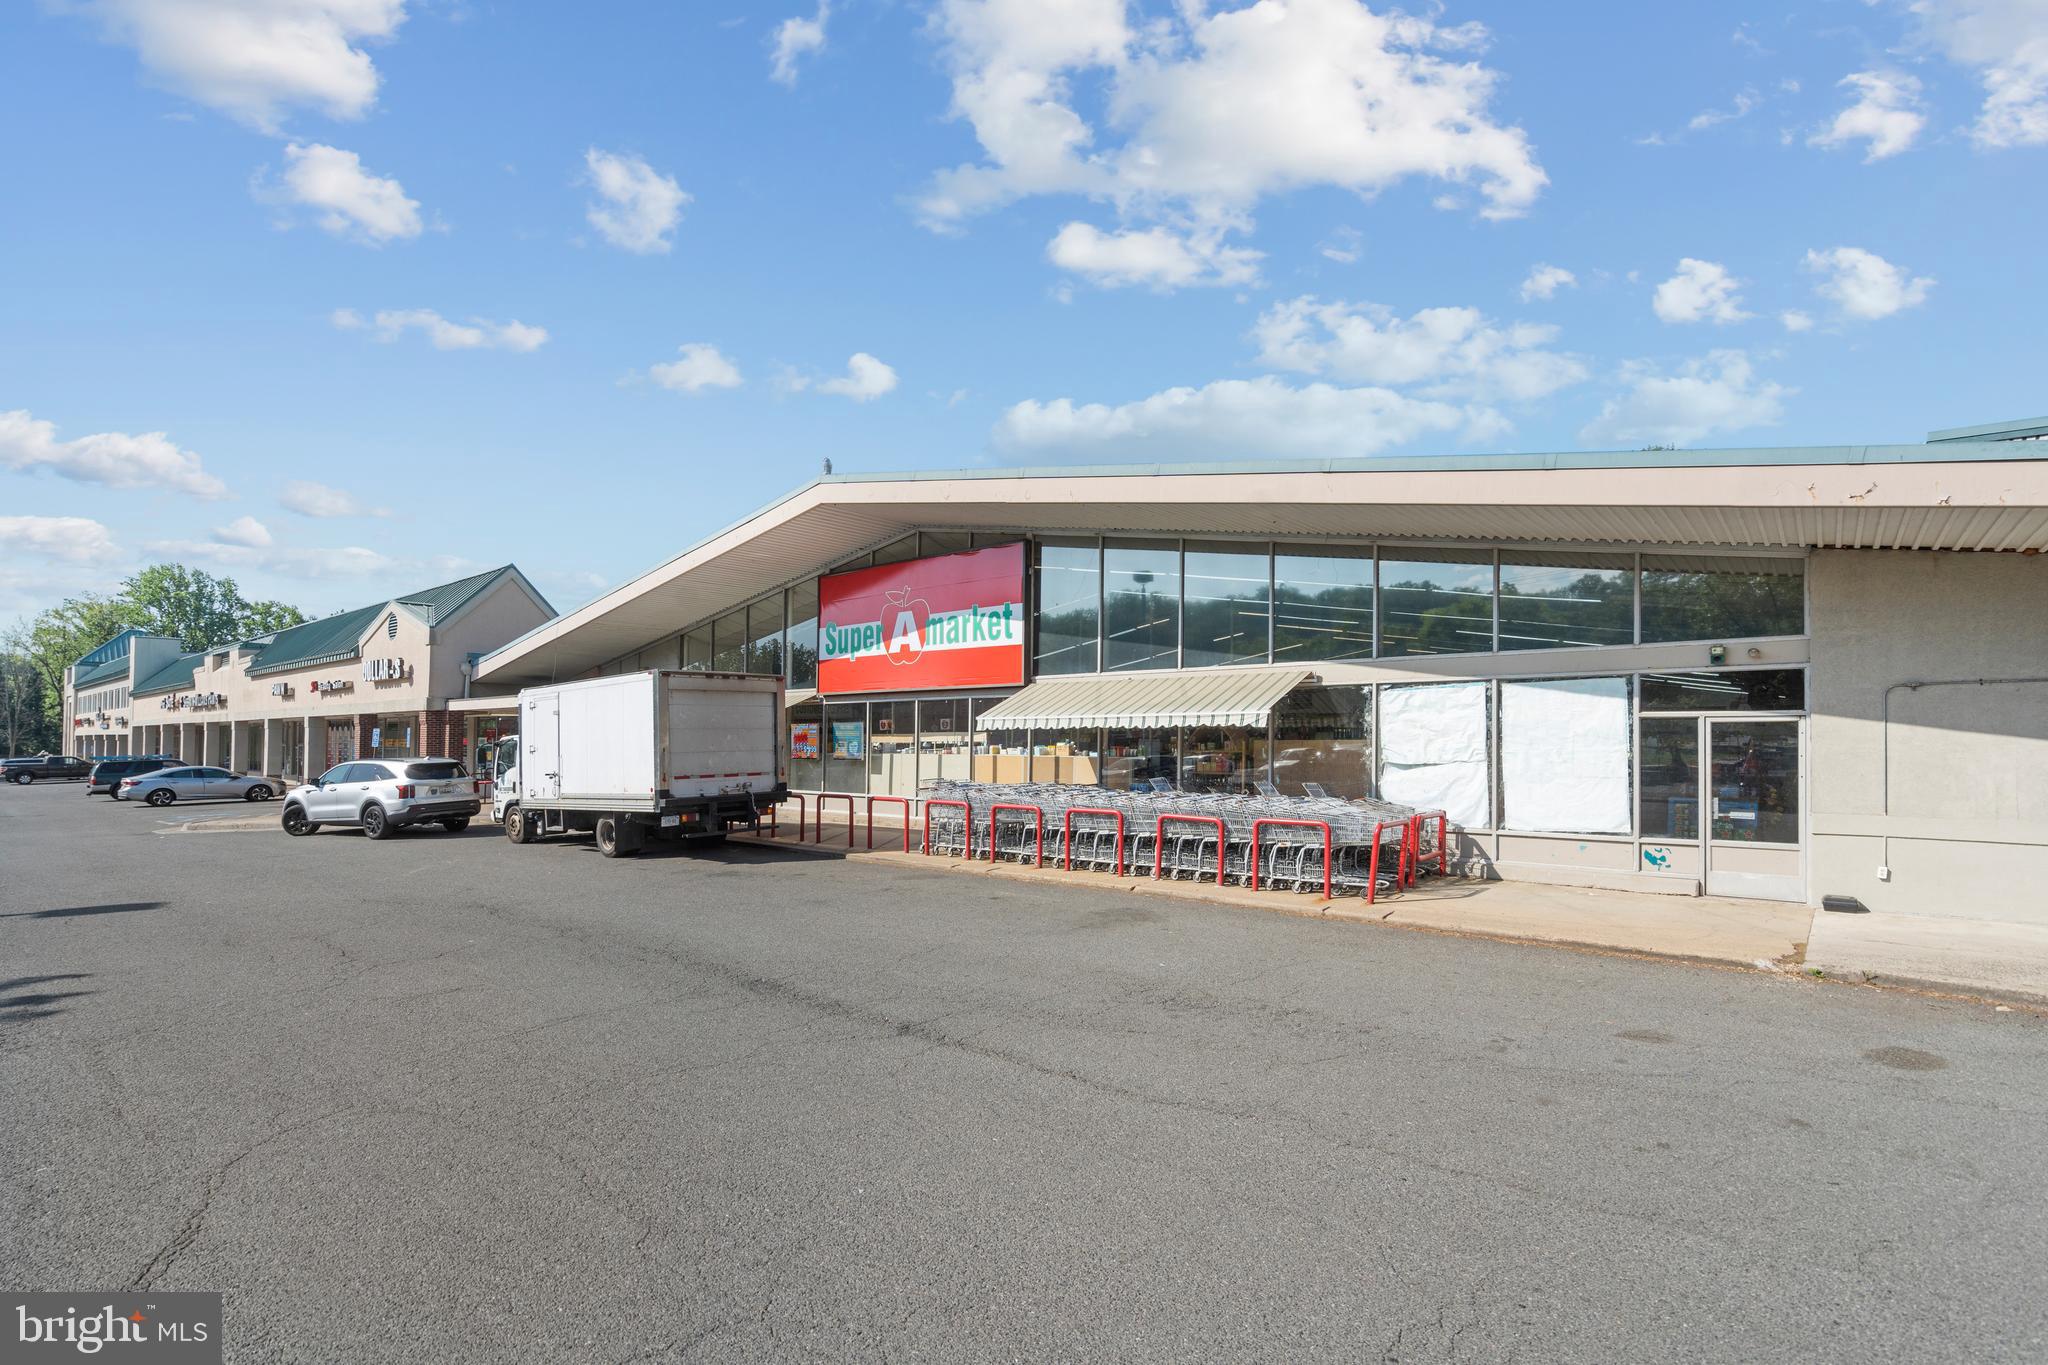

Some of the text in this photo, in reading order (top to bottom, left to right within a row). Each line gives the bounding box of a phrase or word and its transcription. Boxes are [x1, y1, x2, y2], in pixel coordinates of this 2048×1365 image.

[825, 602, 1013, 662] Super A market
